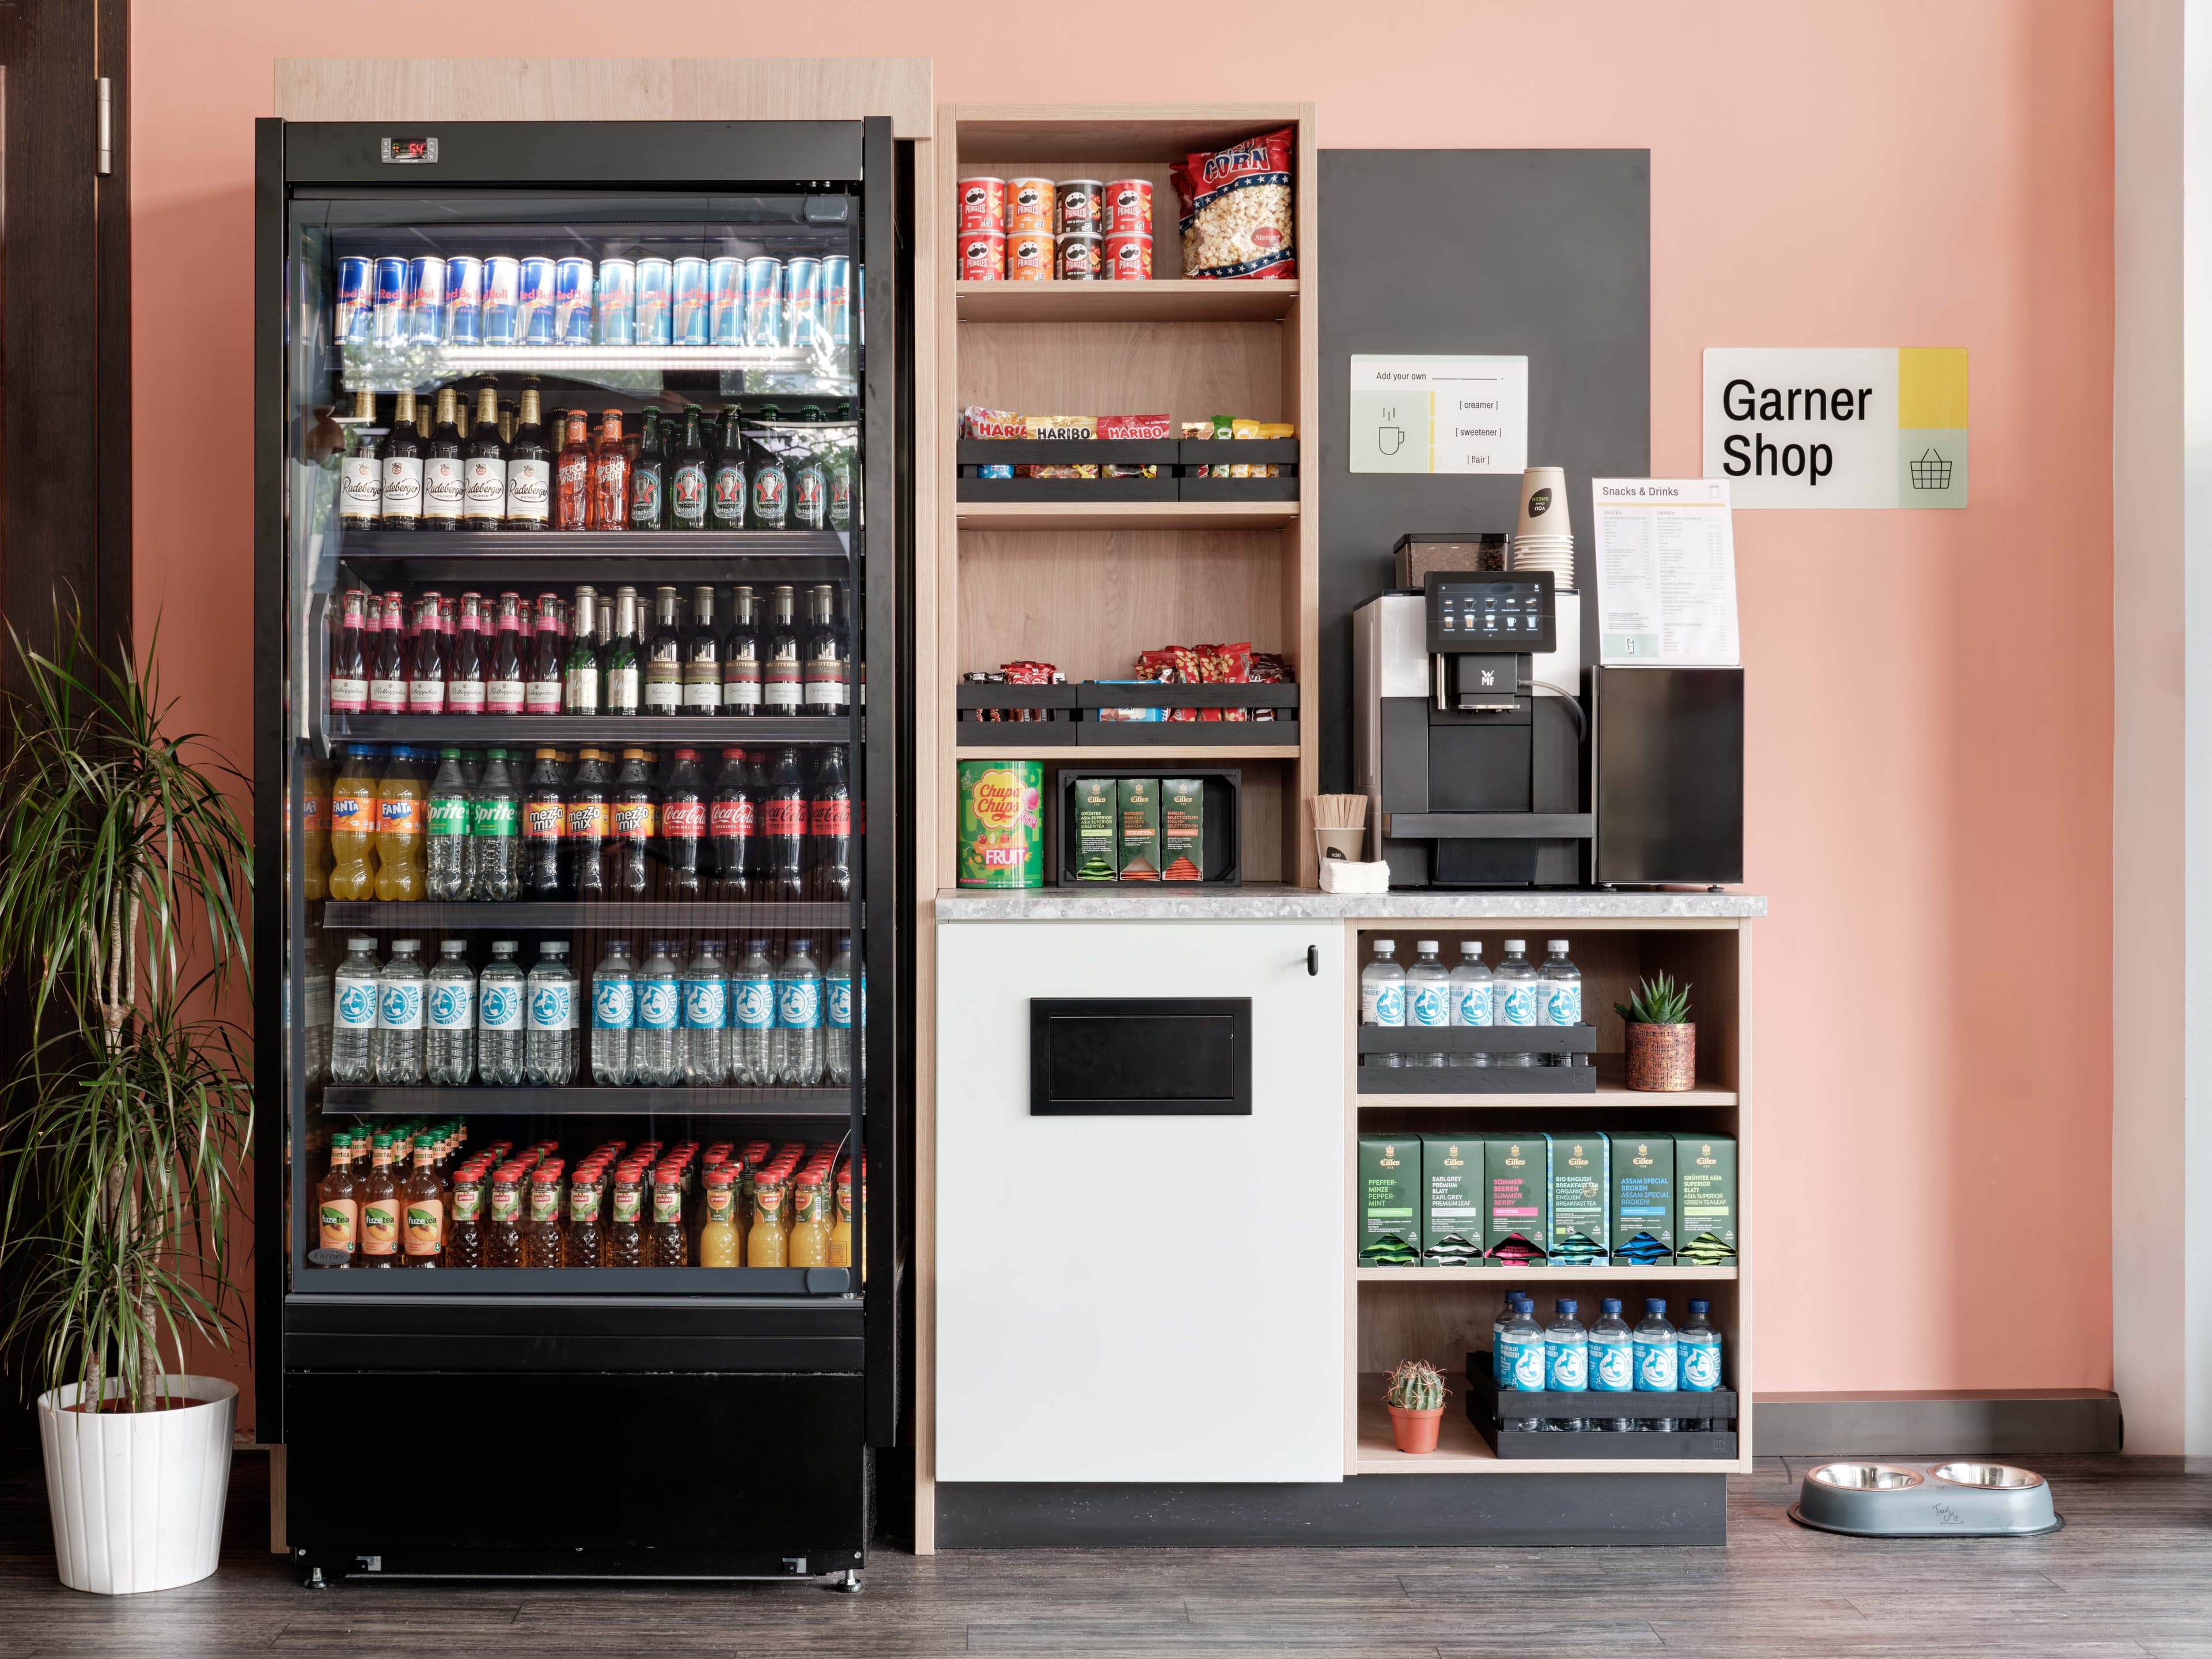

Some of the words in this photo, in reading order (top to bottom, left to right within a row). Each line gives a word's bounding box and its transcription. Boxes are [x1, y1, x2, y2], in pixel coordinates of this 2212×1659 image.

[1203, 146, 1271, 184] CORN
[965, 203, 986, 214] PRINGLES
[1017, 204, 1039, 215] PRINGLES
[1065, 207, 1086, 218] PRINGLES
[1118, 206, 1138, 217] PRINGLES
[1255, 233, 1281, 241] Stenger
[967, 259, 987, 268] PRINGLES
[1017, 259, 1039, 268] PRINGLES
[1066, 260, 1087, 269] PRINGLES
[1119, 259, 1141, 268] PRINGLES
[380, 289, 399, 299] Red
[490, 289, 507, 299] Bull
[520, 289, 535, 300] Red
[557, 289, 574, 300] Red
[1376, 372, 1391, 380] Add
[1393, 373, 1410, 381] your
[1723, 378, 1873, 421] Garner
[979, 422, 1027, 439] HARIB
[1037, 427, 1091, 440] HARIBO
[1108, 426, 1163, 440] HARIBO
[1472, 456, 1486, 464] flair
[1723, 433, 1833, 486] Shop
[595, 461, 626, 478] APEROL
[599, 473, 623, 484] SPRITZ
[342, 476, 382, 497] Radeberger
[425, 478, 464, 497] Radeberger
[509, 479, 547, 498] Radeberger
[1603, 486, 1637, 495] Snacks
[1639, 487, 1646, 495] &
[1649, 487, 1679, 496] Drinks
[979, 784, 1020, 801] Chupa
[333, 800, 359, 812] FANTA
[382, 803, 412, 815] FANTA
[427, 802, 464, 821] Sprite
[978, 798, 1020, 815] Chups
[475, 804, 516, 824] Sprite
[529, 806, 563, 822] mezzo
[615, 806, 649, 821] mezzo
[664, 805, 706, 824] Coca-Cola
[711, 804, 753, 824] Coca-Cola
[533, 818, 557, 831] mix
[618, 818, 641, 832] mix
[986, 849, 1025, 865] FRUIT
[1505, 1158, 1525, 1166] Eilles
[1568, 1158, 1589, 1166] Eilles
[321, 1214, 350, 1224] fuzetea
[366, 1214, 394, 1224] fuzetea
[408, 1215, 437, 1225] fuzetea
[314, 1251, 346, 1260] Carrier
